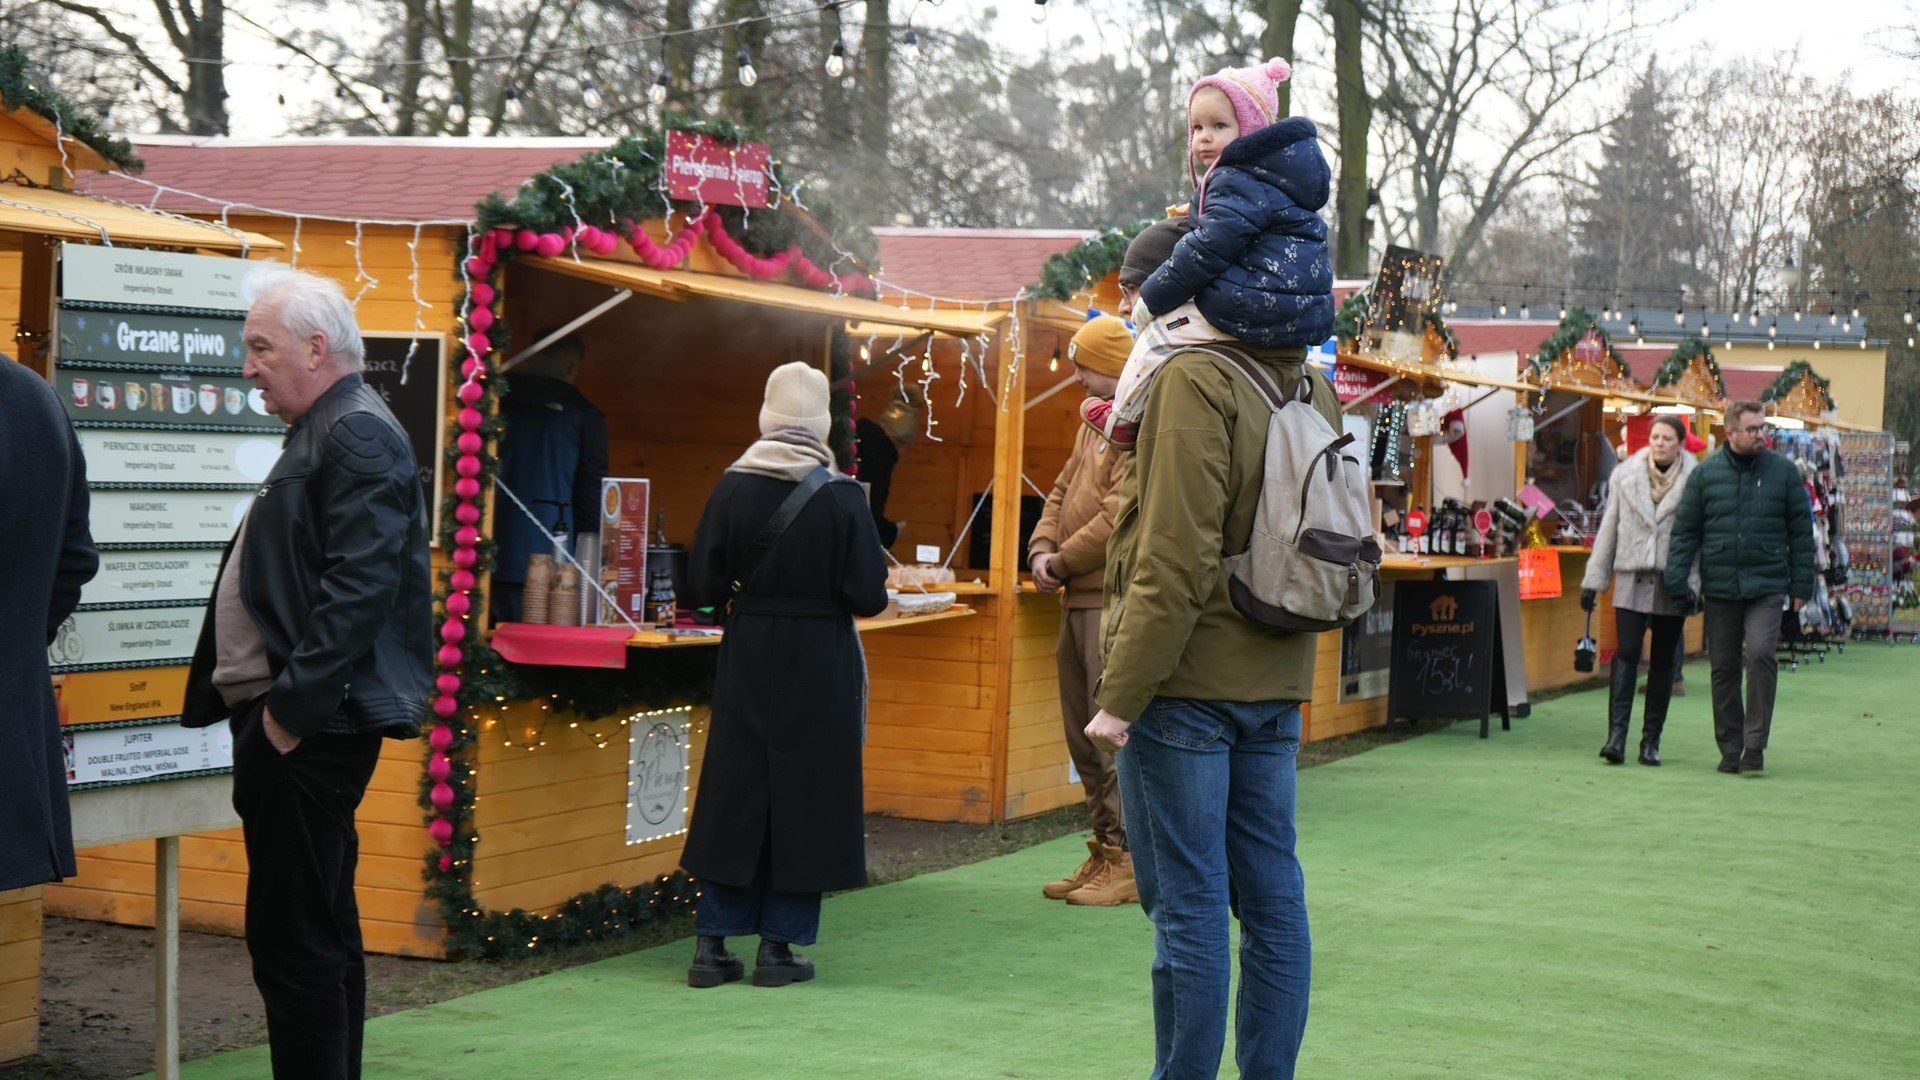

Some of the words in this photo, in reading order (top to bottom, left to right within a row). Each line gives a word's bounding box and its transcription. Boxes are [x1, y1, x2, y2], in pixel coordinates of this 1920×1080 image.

[117, 321, 181, 353] Grzane
[184, 328, 226, 363] piwo
[103, 441, 141, 451] PIERNICZKI
[151, 443, 196, 453] CZEKOLADZIE
[124, 461, 157, 471] Imperialny
[158, 462, 175, 470] Stout
[130, 502, 168, 511] MAKOWIEC
[123, 520, 155, 531] Imperialny
[157, 521, 173, 529] Stout
[105, 562, 137, 572] WAFELEK
[138, 561, 189, 571] CZEKOLADOWY
[144, 619, 190, 630] CZEKOLADZIE
[1411, 621, 1474, 636] Pyszne.pl
[125, 702, 150, 712] England
[124, 732, 153, 747] JUPITER
[88, 754, 114, 765] DOUBLE
[115, 751, 141, 762] FRUITED
[142, 748, 172, 759] IMPERIAL
[173, 746, 190, 756] GOSE
